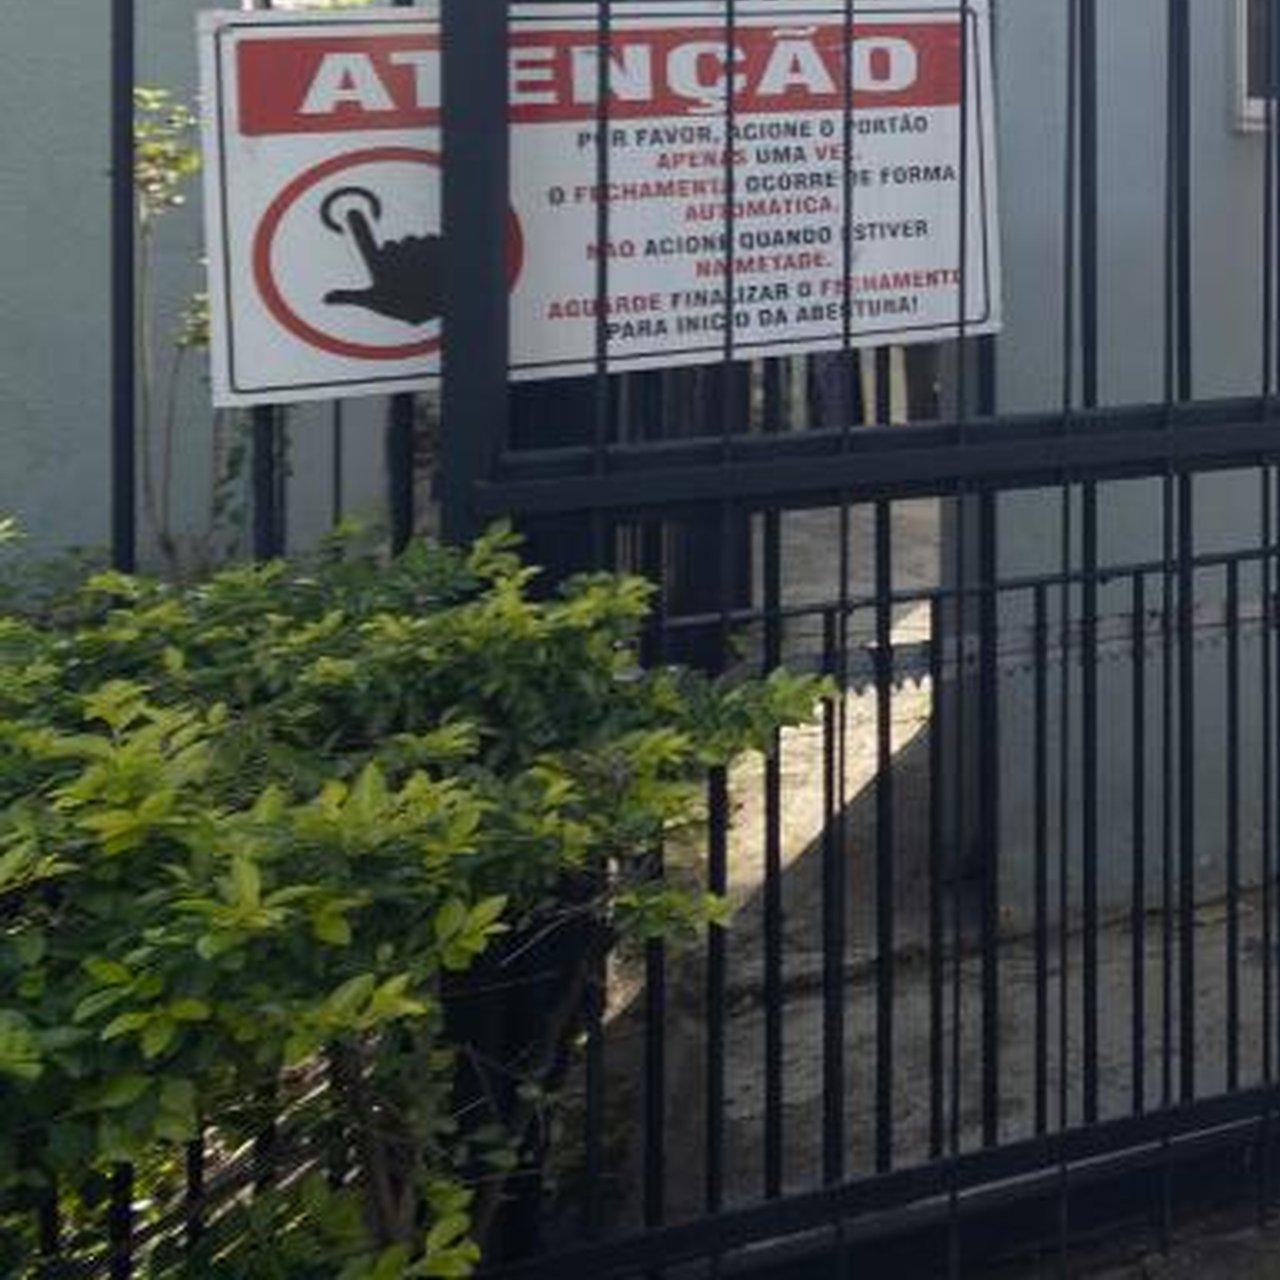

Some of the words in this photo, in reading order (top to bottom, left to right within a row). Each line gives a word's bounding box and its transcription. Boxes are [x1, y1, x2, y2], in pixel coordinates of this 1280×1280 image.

[300, 25, 916, 114] ATENÇÃO
[577, 128, 627, 148] PR
[820, 120, 834, 138] O
[756, 146, 808, 165] UMA
[880, 165, 957, 186] FORMA
[740, 227, 832, 250] QUANDO
